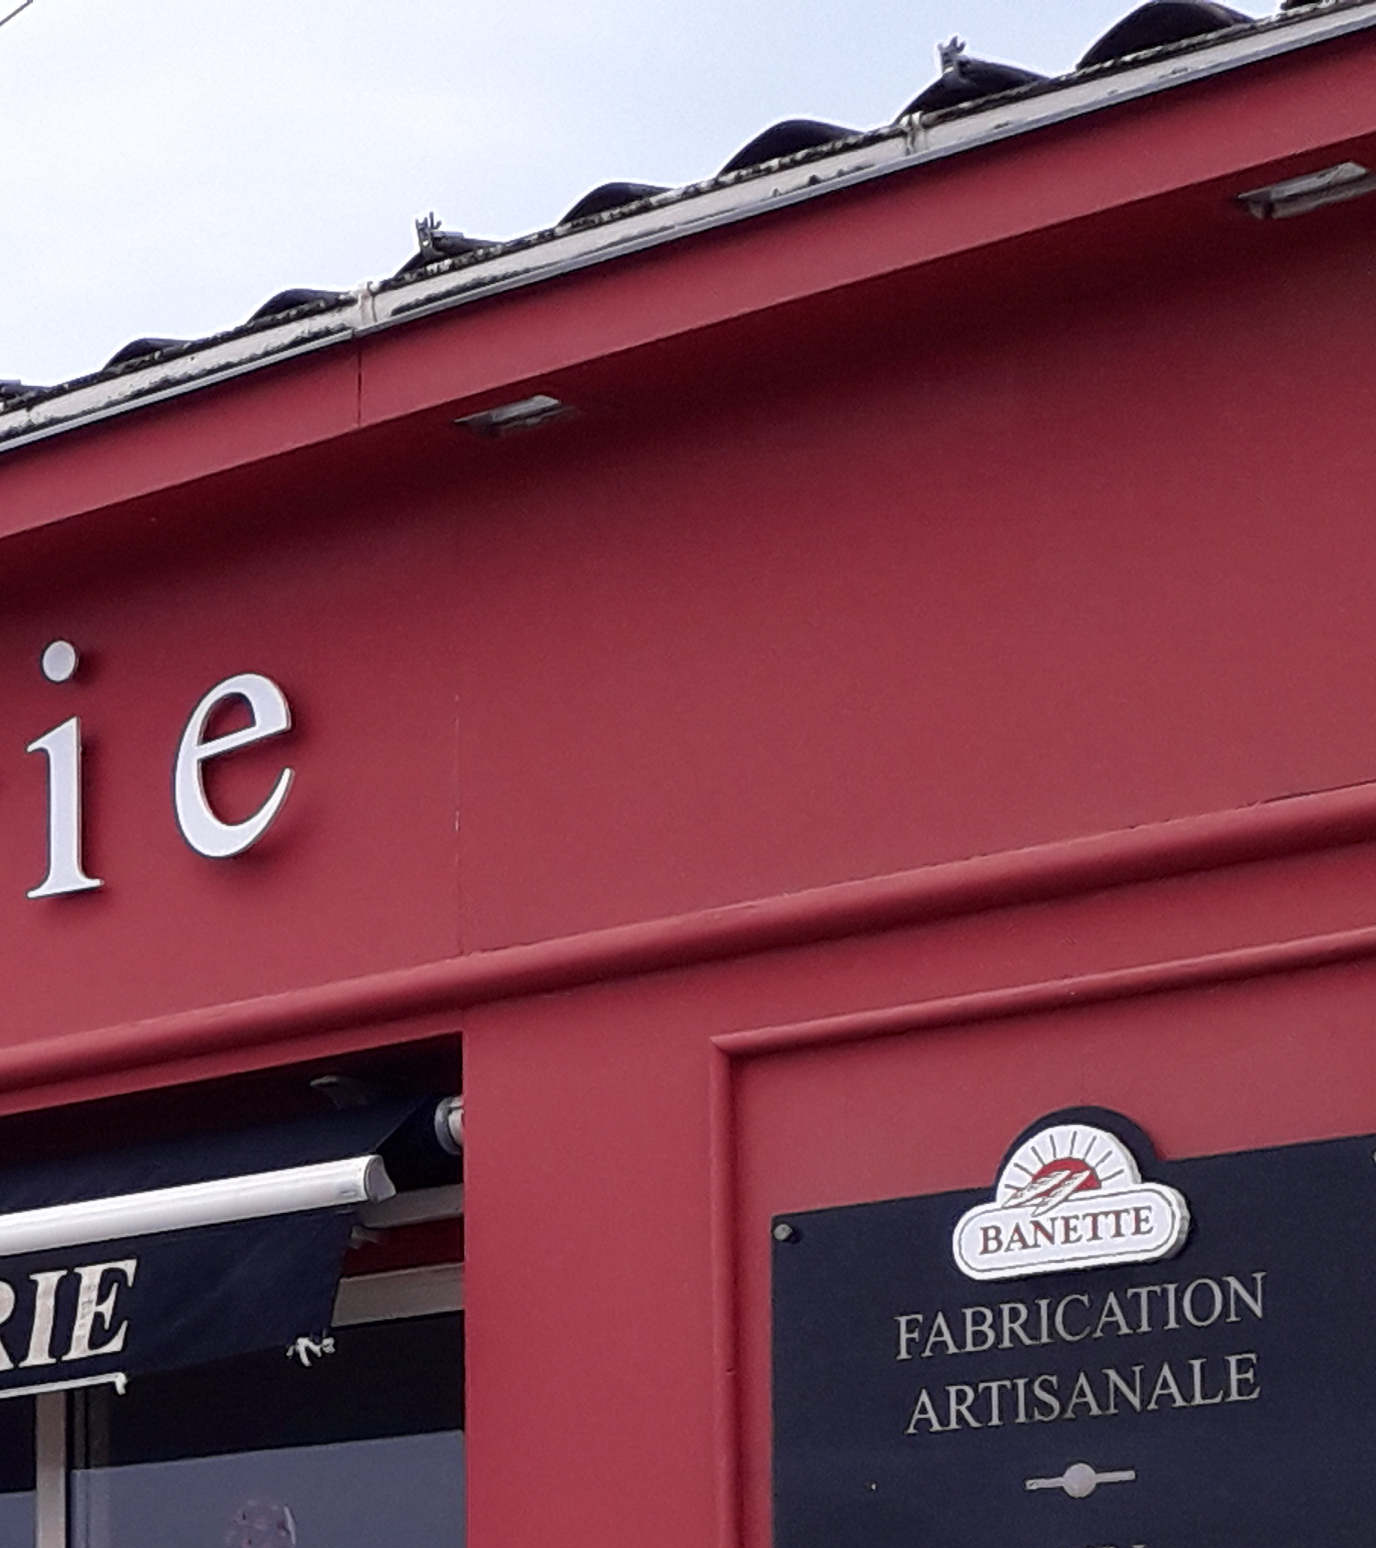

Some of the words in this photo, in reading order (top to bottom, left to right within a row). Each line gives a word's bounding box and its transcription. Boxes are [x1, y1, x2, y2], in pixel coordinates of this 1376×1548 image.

[978, 1205, 1155, 1256] BANETTE
[893, 1271, 1267, 1362] FABRICATION
[904, 1353, 1262, 1434] ARTISANALE
